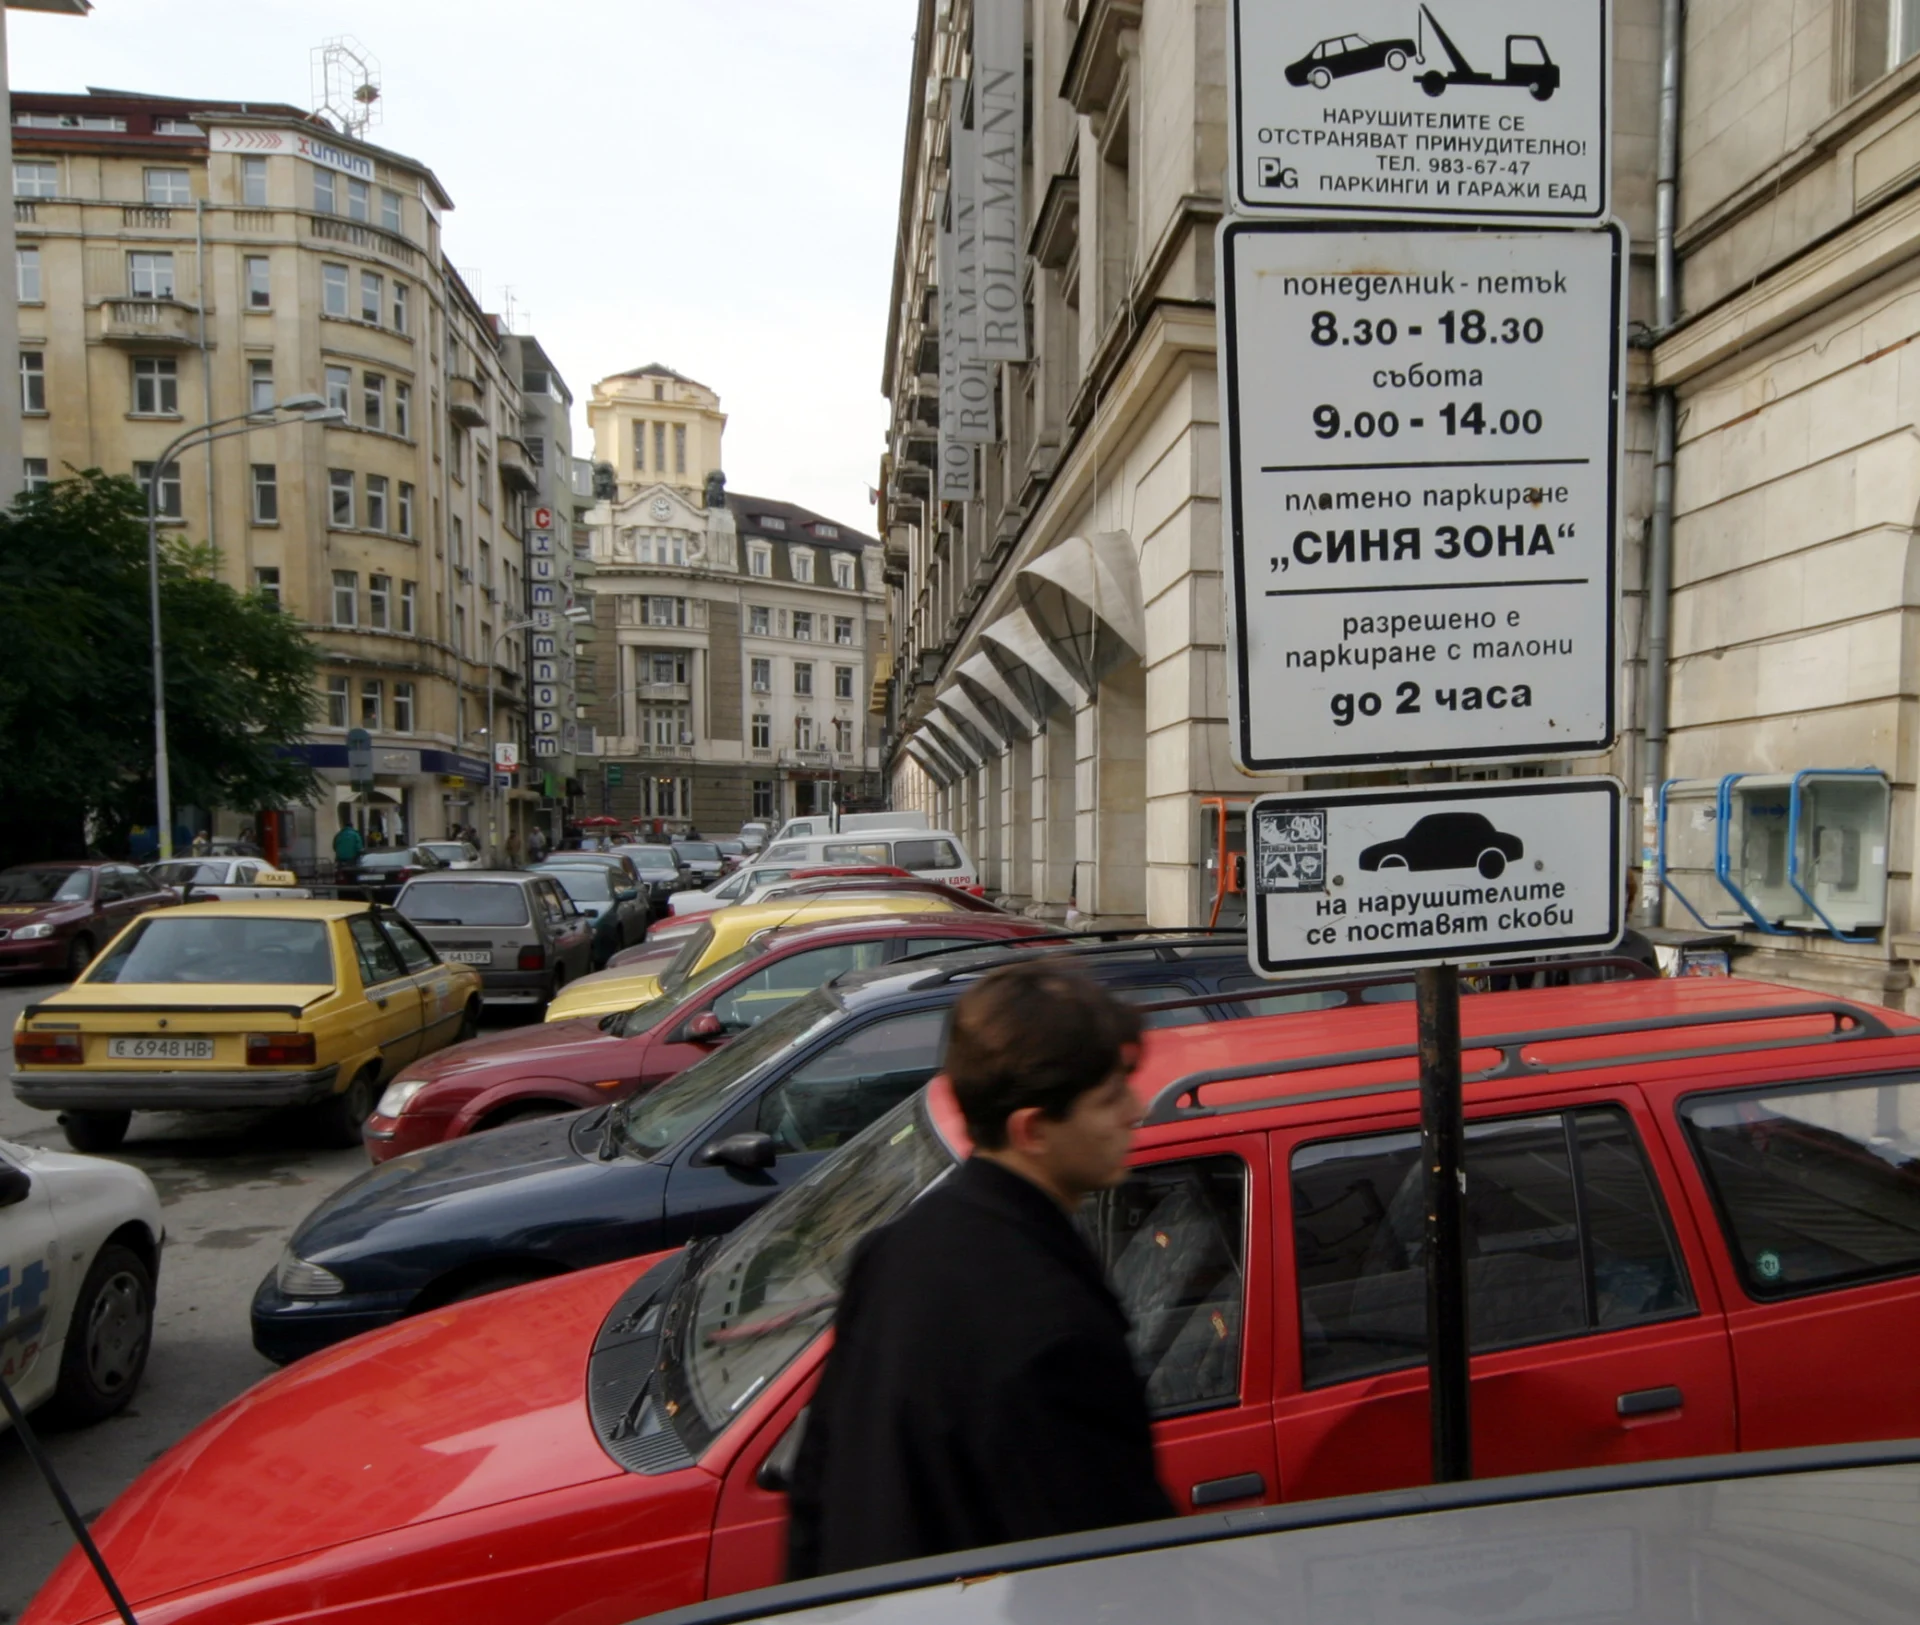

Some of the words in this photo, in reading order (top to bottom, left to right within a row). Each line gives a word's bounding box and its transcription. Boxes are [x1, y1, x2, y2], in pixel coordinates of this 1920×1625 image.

[1324, 108, 1489, 130] НАРУШИТЕЛИТЕ
[1499, 116, 1524, 131] СЕ
[1258, 128, 1408, 149] ОТСТРАНЯВАТ
[1417, 135, 1585, 155] ПРИНУДИТЕЛНО!
[1377, 155, 1419, 171] ТЕЛ.
[1429, 158, 1530, 175] 983-67-47
[1320, 176, 1427, 194] ПАРКИНГИ
[1437, 181, 1449, 194] И
[1458, 181, 1539, 197] ГАРАЖИ
[1549, 184, 1586, 201] ЕАД
[982, 64, 1018, 347] ROLLMANN
[1284, 271, 1454, 301] понеделник
[1478, 271, 1566, 293] петък
[1311, 311, 1397, 346] 8.30
[1439, 310, 1543, 344] 18.30
[1373, 363, 1482, 388] събота
[1313, 405, 1399, 439] 9.00
[1440, 402, 1542, 435] 14.00
[1286, 491, 1411, 511] платено
[1424, 483, 1568, 509] паркиране
[1344, 612, 1495, 640] разрешено
[1507, 611, 1519, 627] е
[1287, 644, 1435, 670] паркиране
[1448, 644, 1460, 660] с
[1473, 639, 1572, 658] талони
[1331, 692, 1381, 726] до
[1396, 681, 1420, 714] 2
[1436, 685, 1531, 711] часа
[1317, 899, 1346, 916] на
[1359, 883, 1565, 917] нарушителите
[1307, 928, 1336, 945] се
[1348, 916, 1487, 941] поставят
[1498, 906, 1573, 930] скоби
[133, 1040, 180, 1056] 6948
